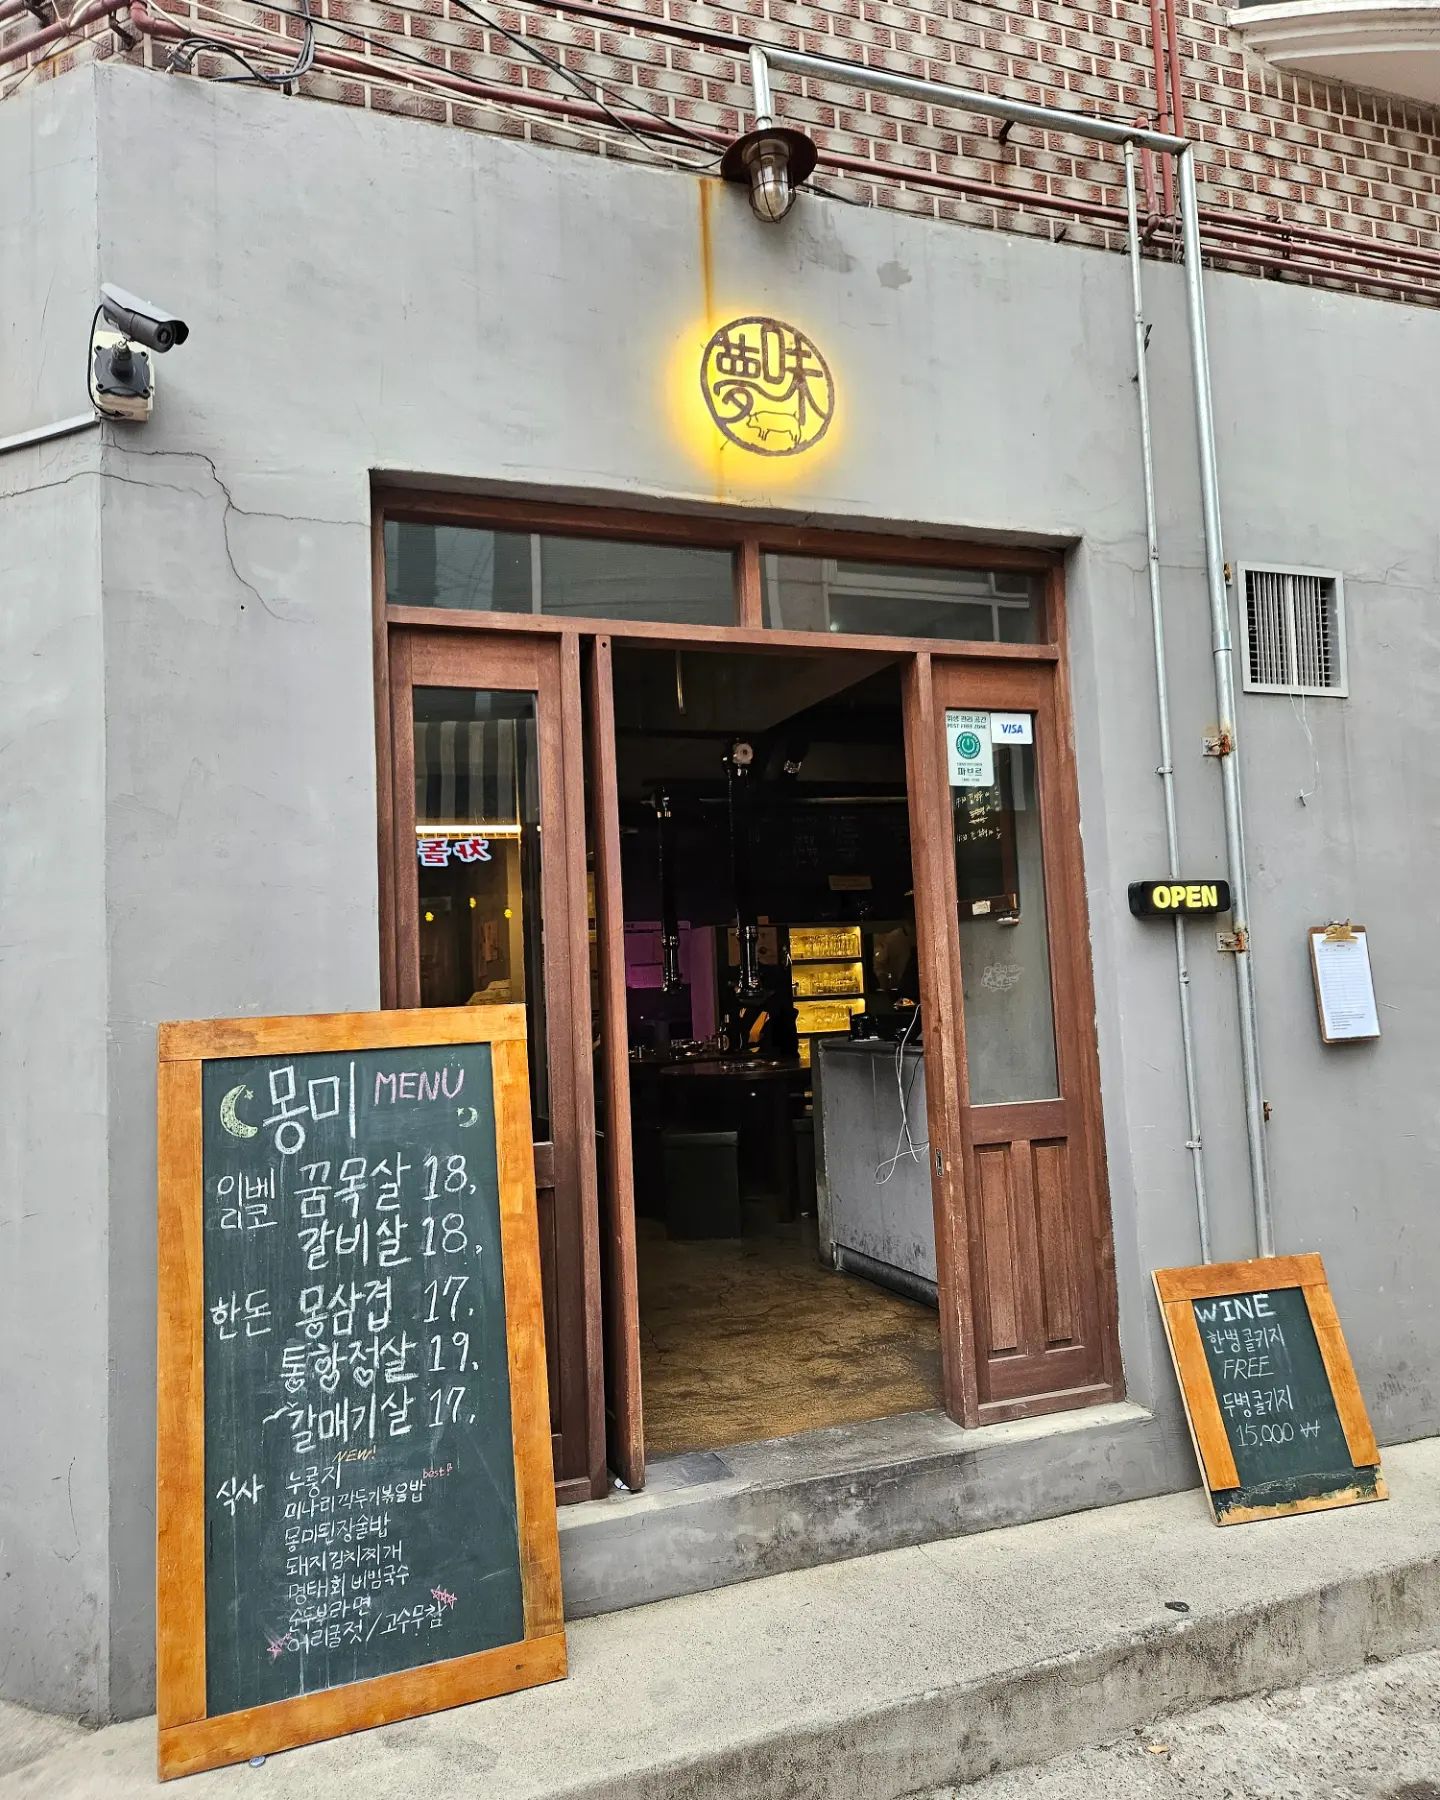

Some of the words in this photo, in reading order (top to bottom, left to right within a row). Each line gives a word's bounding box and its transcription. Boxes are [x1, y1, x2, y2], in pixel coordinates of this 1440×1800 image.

[1001, 723, 1024, 734] VISA
[1152, 884, 1218, 909] OPEN
[263, 1061, 357, 1154] 몽미
[374, 1067, 464, 1106] MENU
[293, 1152, 412, 1218] 꿈목살
[297, 1213, 412, 1271] 갈비살
[209, 1288, 273, 1341] 한돈
[295, 1276, 393, 1338] 몽삼겹
[1195, 1293, 1276, 1323] WINE
[279, 1330, 419, 1394] 통항정살
[1223, 1355, 1275, 1380] FREE
[287, 1385, 417, 1454] 갈매기살
[332, 1445, 377, 1464] NEW!
[216, 1473, 265, 1517] 식사
[285, 1462, 341, 1498] 누룽지
